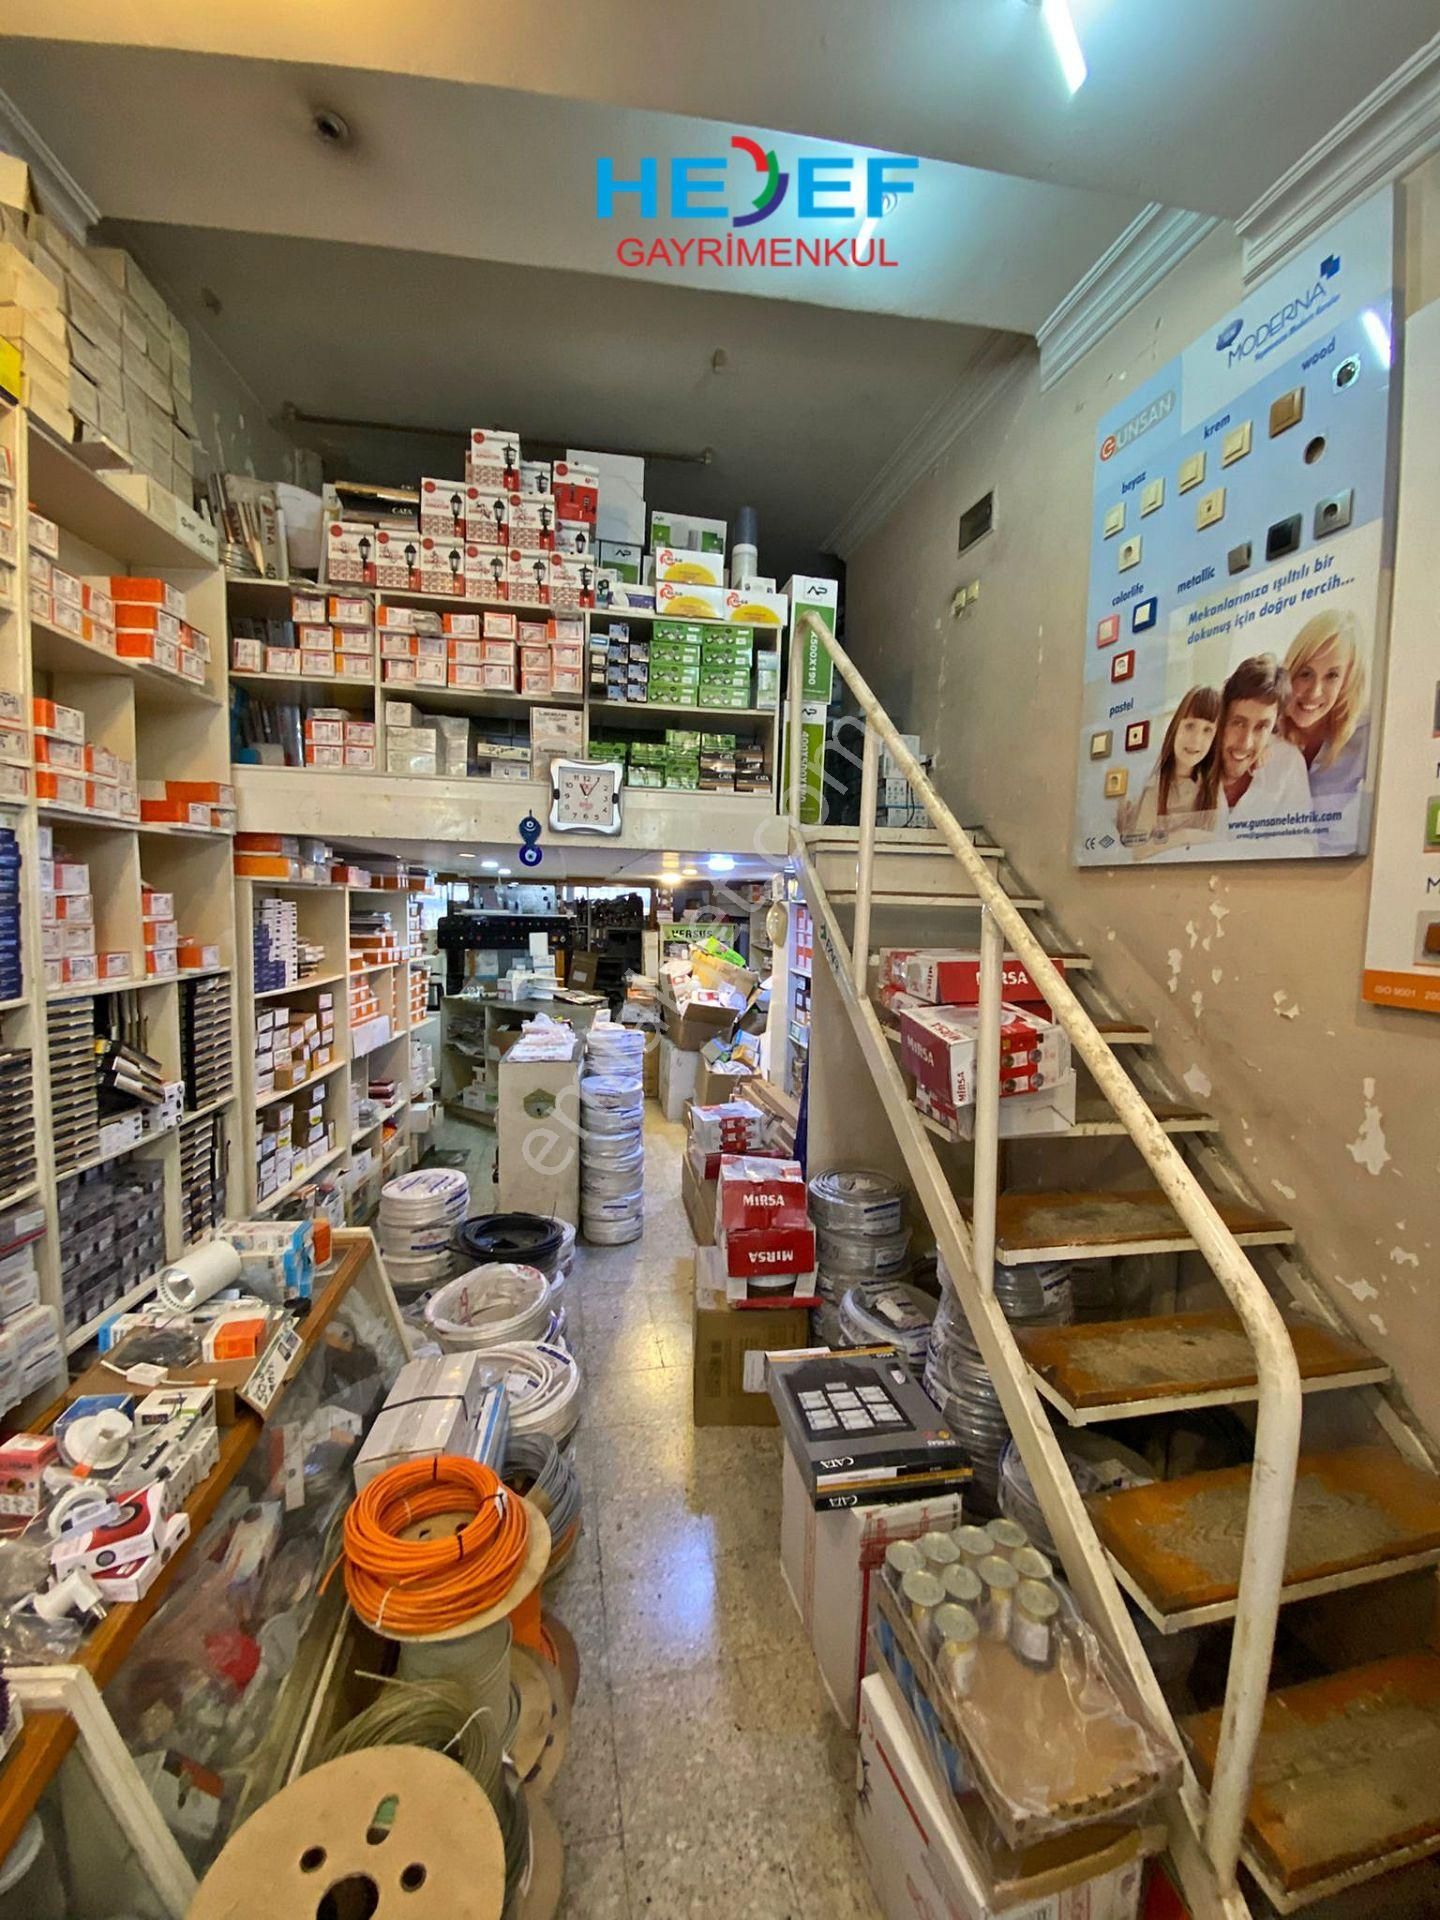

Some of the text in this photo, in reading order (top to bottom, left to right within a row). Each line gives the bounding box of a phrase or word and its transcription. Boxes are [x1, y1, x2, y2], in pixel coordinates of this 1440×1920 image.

[1228, 281, 1326, 368] MODERNA
[1301, 336, 1336, 370] wood
[1203, 413, 1231, 440] krem
[1177, 564, 1216, 594] metallic
[1188, 582, 1269, 626] Mekanlarınıza
[1314, 553, 1336, 573] bir
[1187, 619, 1232, 645] dokunuş
[1234, 610, 1256, 628] için
[1259, 593, 1297, 618] doğru
[1109, 698, 1134, 718] pastel
[975, 970, 1029, 986] RSA
[820, 1456, 855, 1469] CATA
